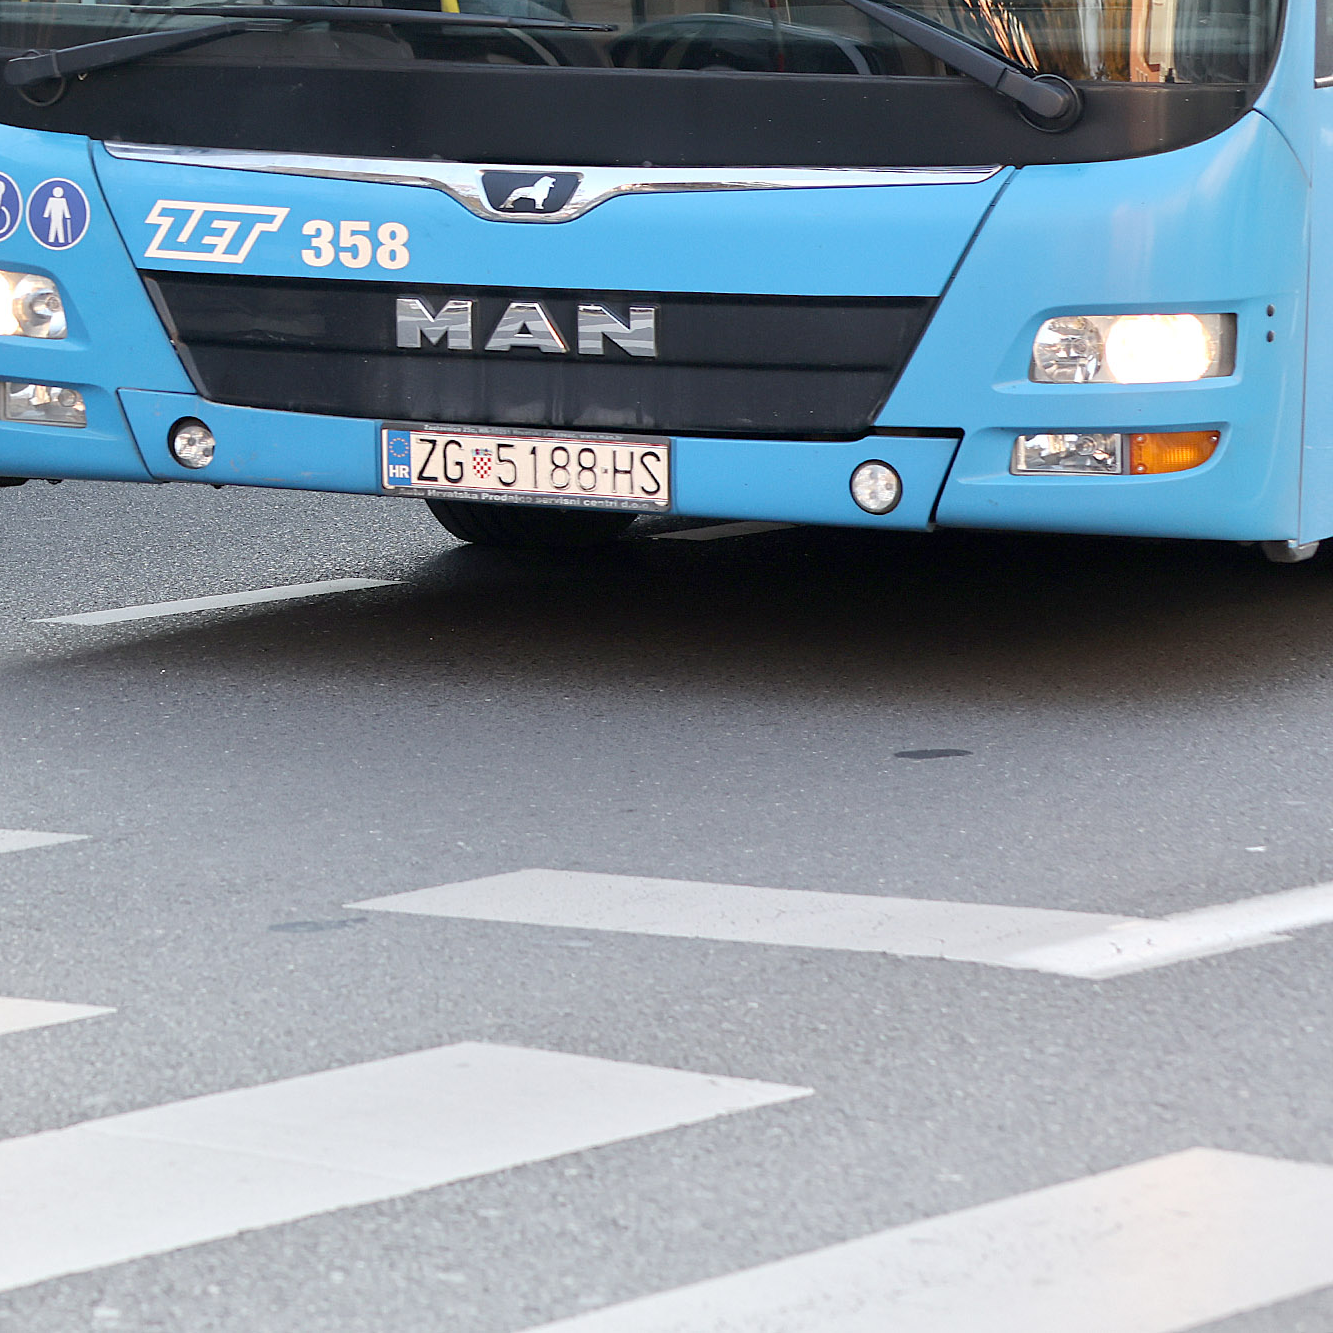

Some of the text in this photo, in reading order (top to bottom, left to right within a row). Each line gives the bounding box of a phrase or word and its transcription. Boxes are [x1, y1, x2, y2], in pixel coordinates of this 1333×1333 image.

[143, 199, 290, 265] ZET
[301, 220, 410, 270] 358
[394, 295, 660, 358] MAN
[388, 464, 410, 478] HR
[417, 438, 464, 484] ZG
[427, 489, 479, 500] Hrvatska
